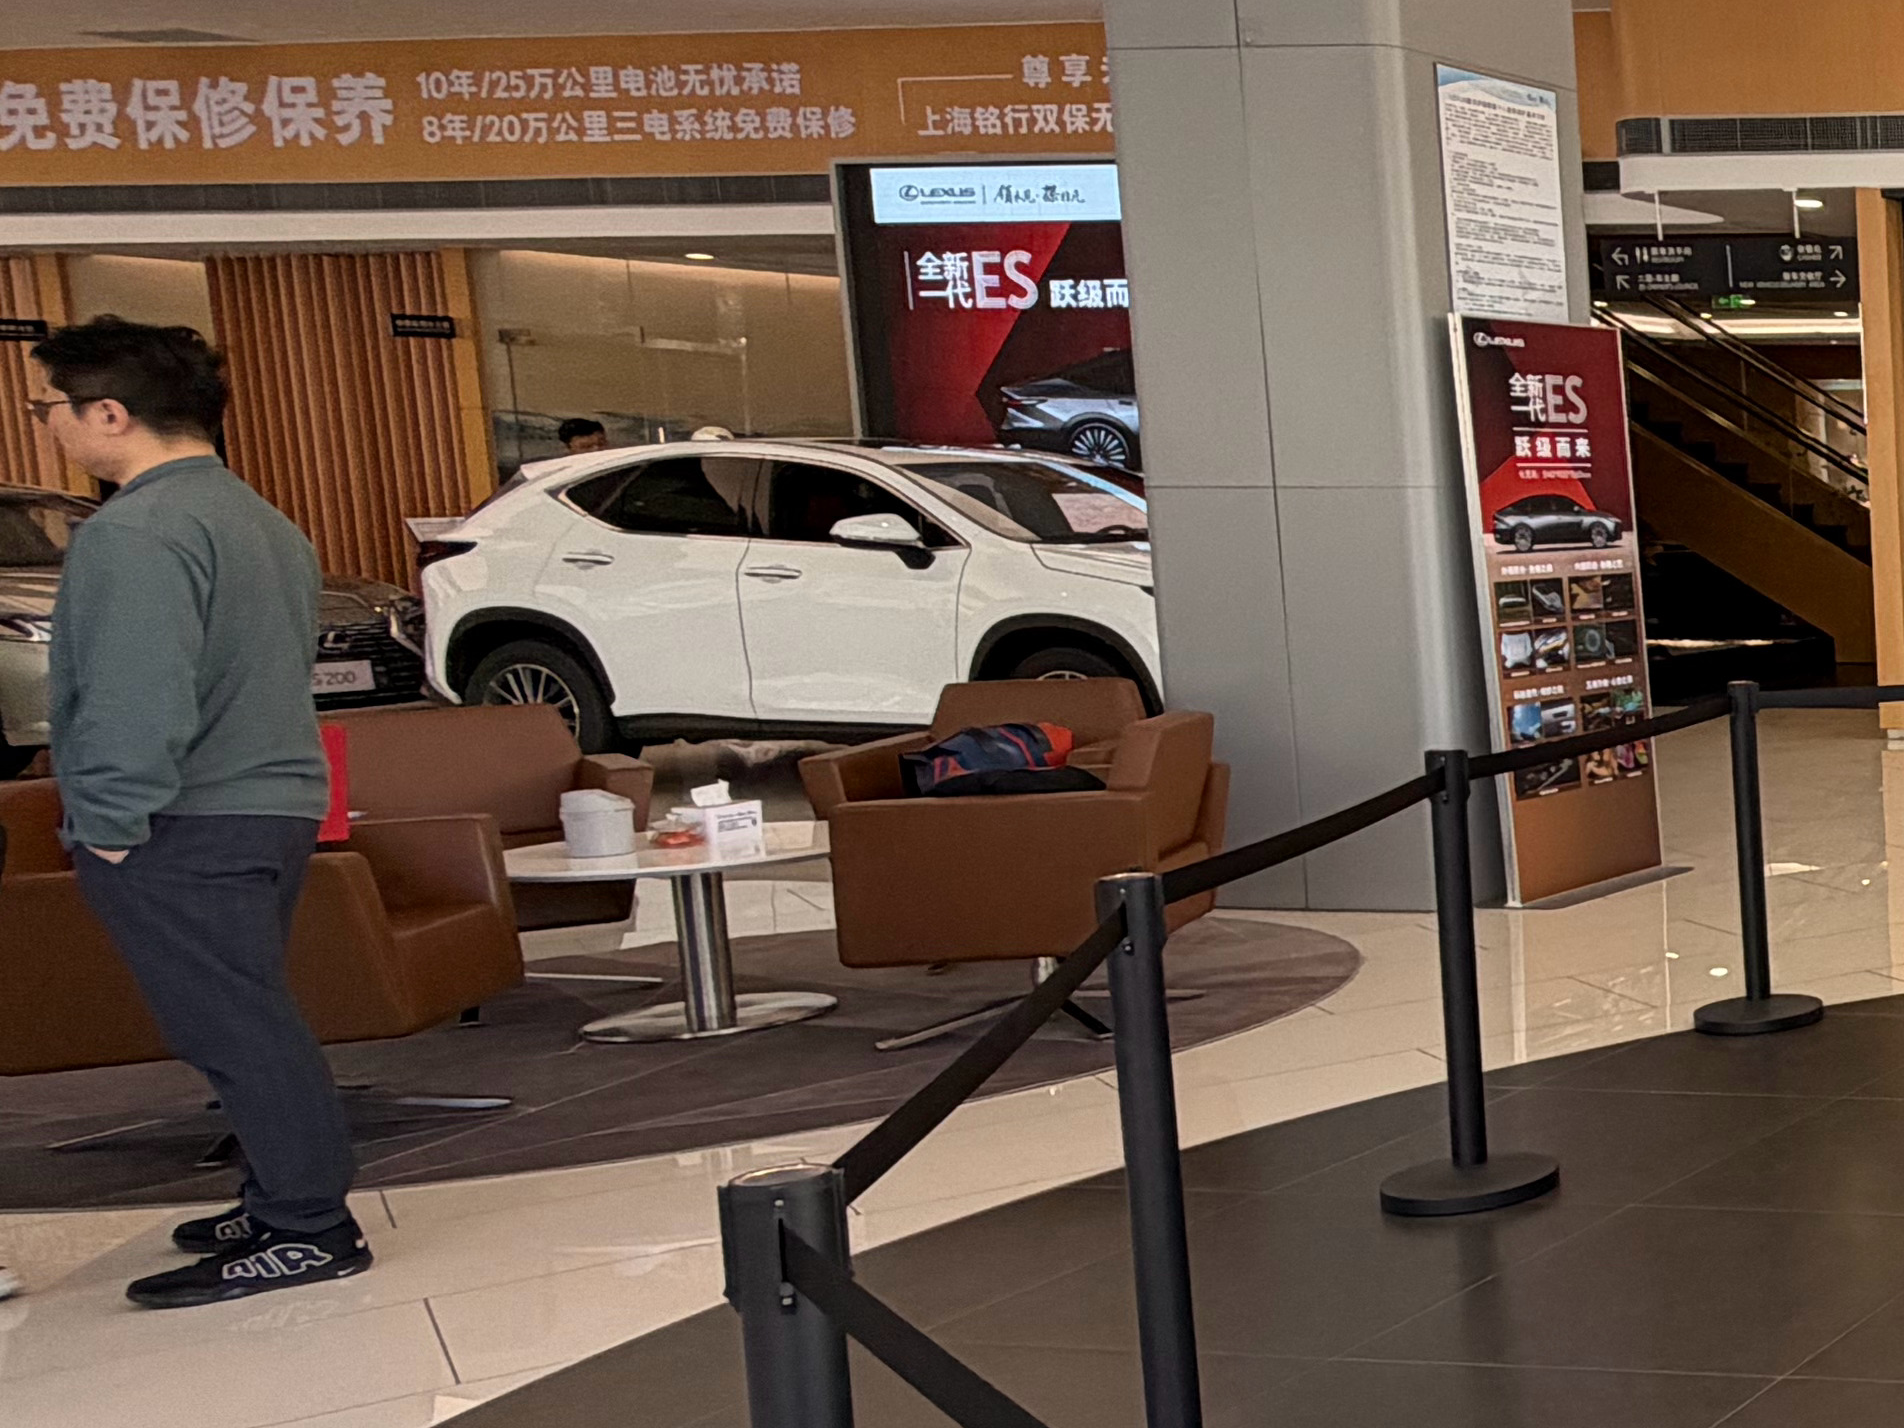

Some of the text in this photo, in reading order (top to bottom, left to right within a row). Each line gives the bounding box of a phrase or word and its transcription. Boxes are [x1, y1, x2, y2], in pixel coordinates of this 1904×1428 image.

[416, 62, 802, 99] 10年/25万公里电池无忧承诺
[0, 72, 394, 152] 免费保修保养
[422, 106, 857, 145] 8年/20万公里三电系统免费保修
[916, 251, 969, 282] 全新
[972, 250, 1038, 310] ES
[1545, 374, 1588, 424] ES
[222, 1243, 333, 1279] AIR
